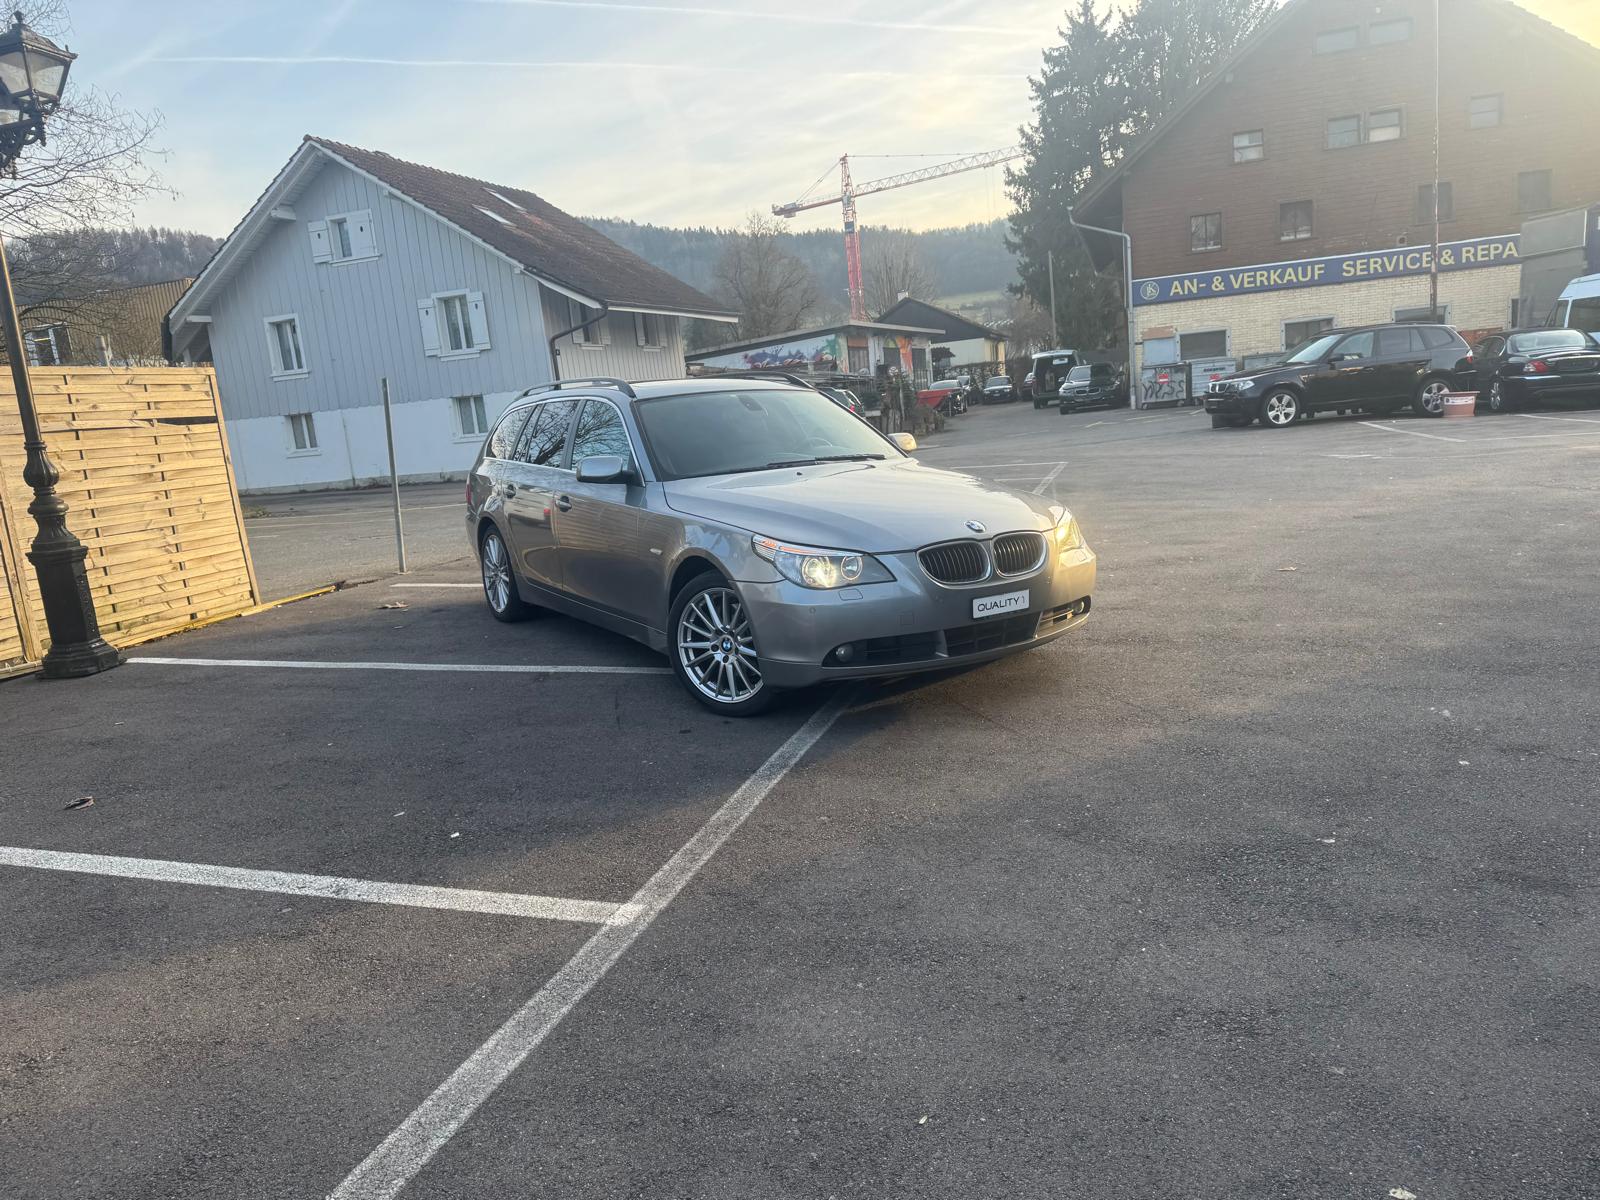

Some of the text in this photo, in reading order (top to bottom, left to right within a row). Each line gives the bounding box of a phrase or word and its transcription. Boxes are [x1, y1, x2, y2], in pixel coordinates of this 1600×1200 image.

[1169, 241, 1519, 297] AN- & VERKAUF SERVICE & REPA
[978, 597, 1019, 612] QUALITY
